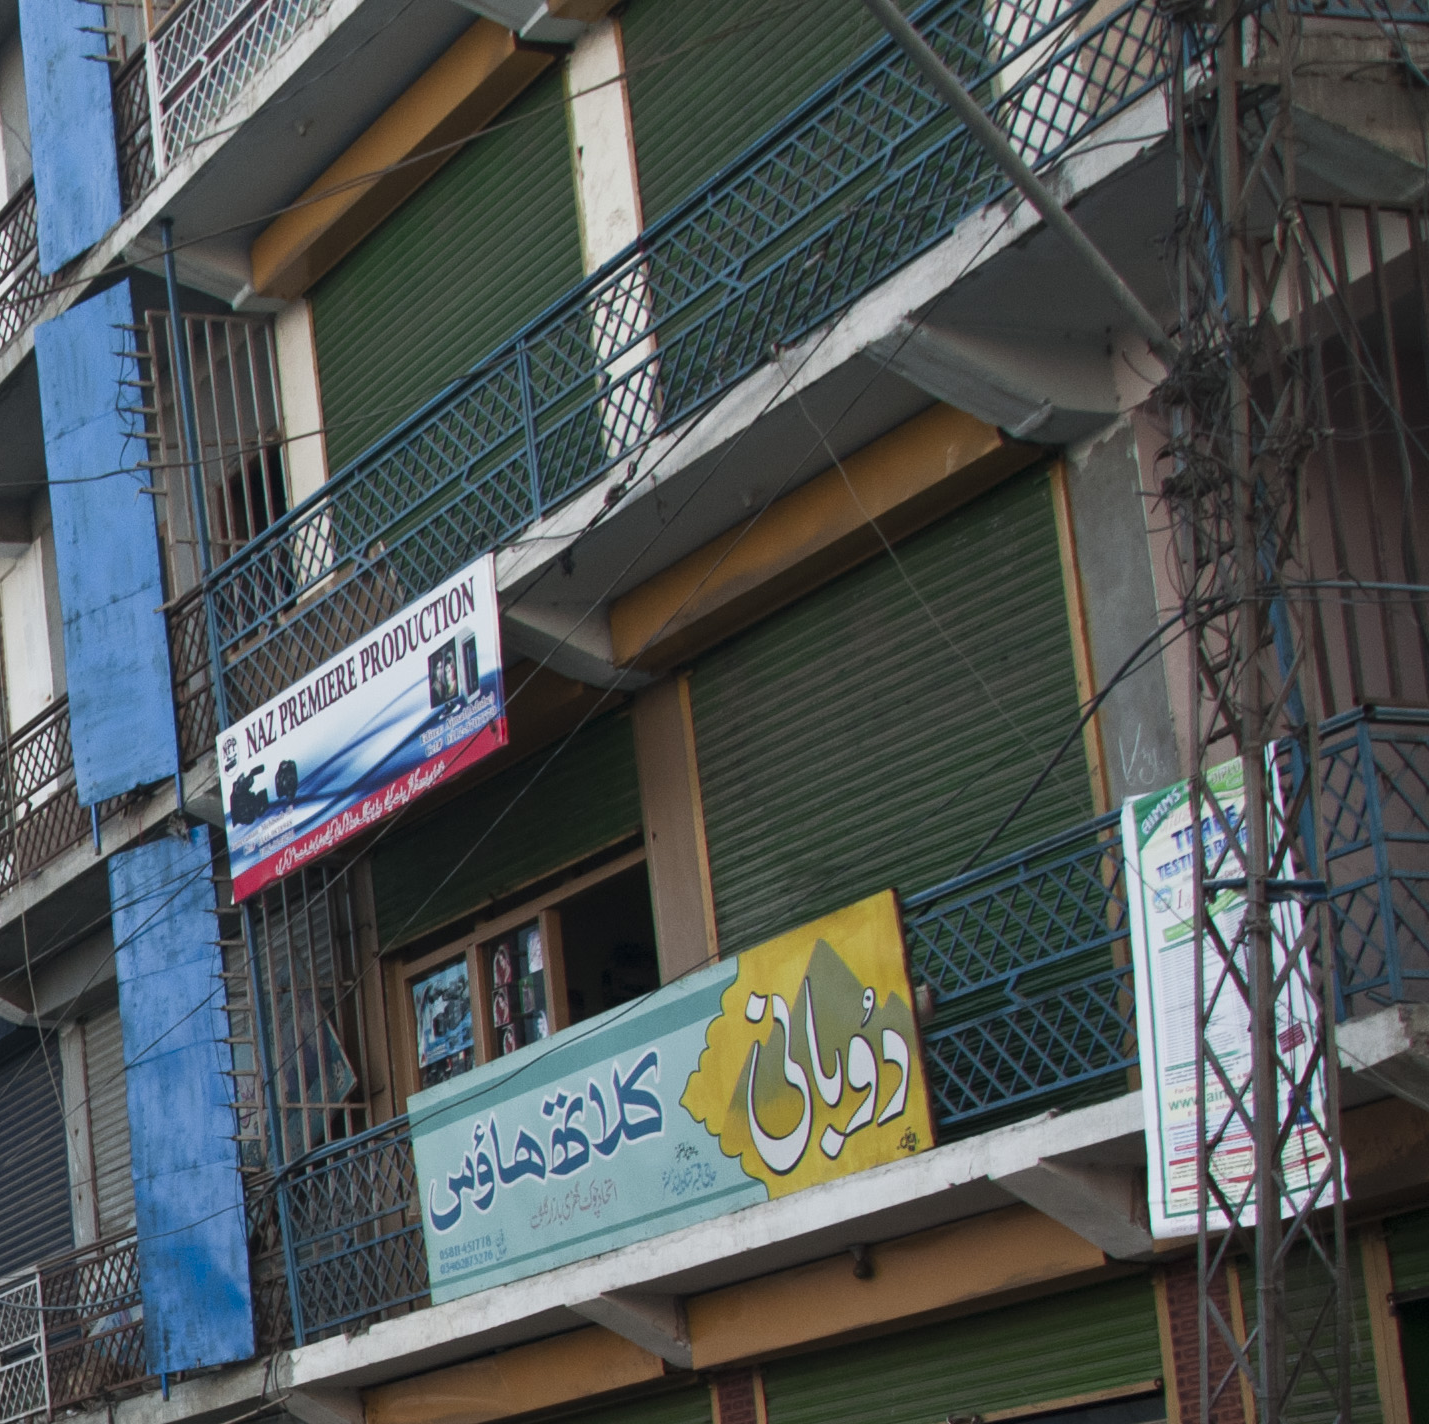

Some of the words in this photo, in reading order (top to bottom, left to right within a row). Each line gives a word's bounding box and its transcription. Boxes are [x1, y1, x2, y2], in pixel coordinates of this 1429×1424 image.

[245, 709, 277, 759] NAZ
[279, 656, 358, 737] PREMIERE
[359, 576, 477, 685] PRODUCTION
[1211, 758, 1244, 786] DIPLO
[1156, 845, 1212, 881] TESTIG
